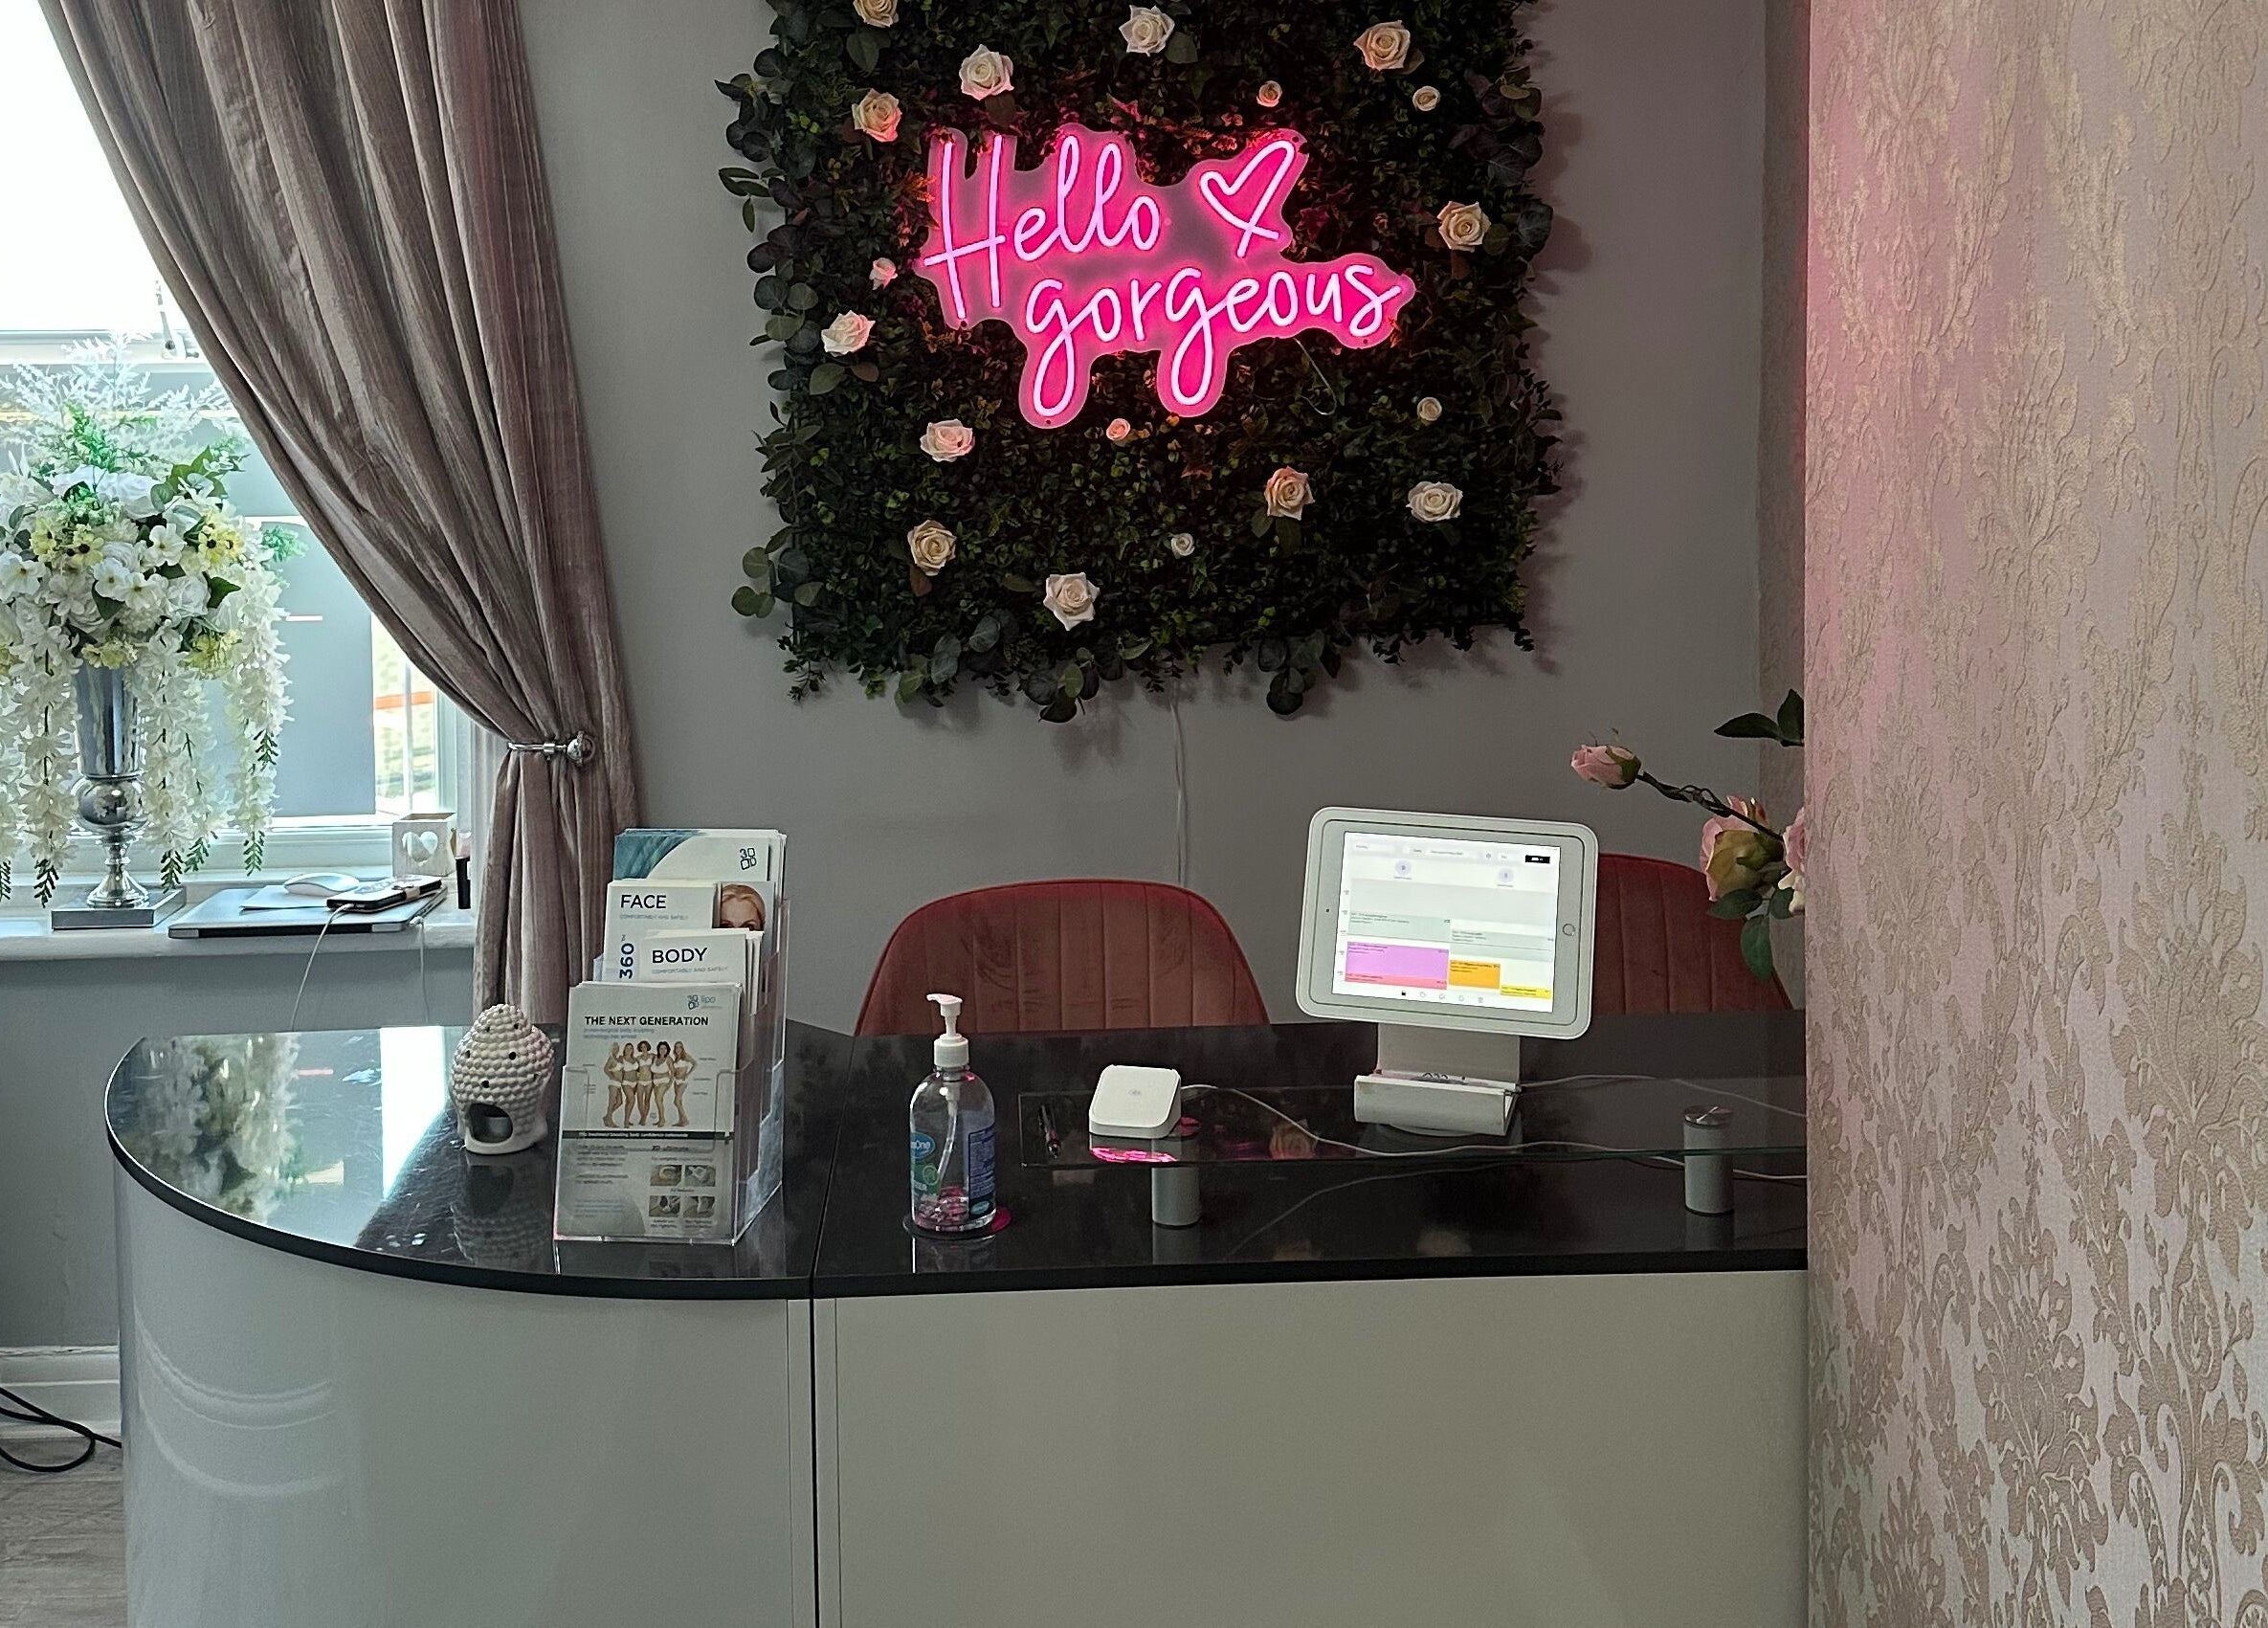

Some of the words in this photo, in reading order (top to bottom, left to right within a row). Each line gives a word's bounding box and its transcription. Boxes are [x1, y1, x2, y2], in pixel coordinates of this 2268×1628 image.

[923, 134, 1161, 321] Hello
[1025, 264, 1403, 418] gorgeous
[620, 894, 667, 909] FACE
[619, 943, 634, 979] 360
[652, 947, 708, 964] BODY
[585, 1015, 606, 1026] THE
[609, 1015, 636, 1026] NEXT
[639, 1016, 709, 1026] GENERATION
